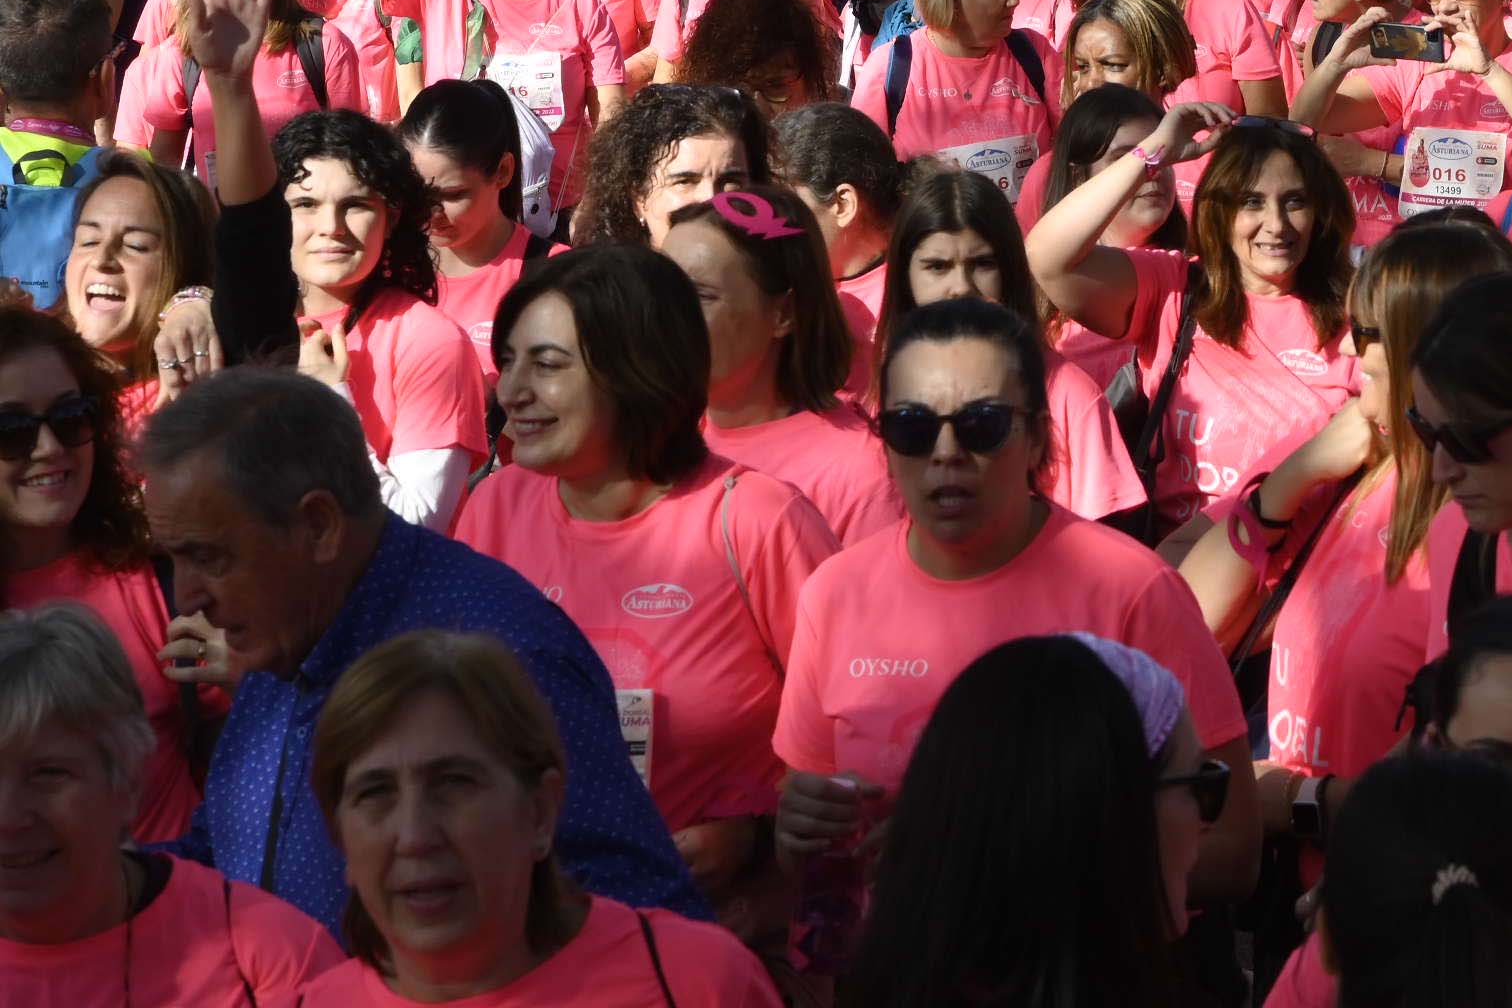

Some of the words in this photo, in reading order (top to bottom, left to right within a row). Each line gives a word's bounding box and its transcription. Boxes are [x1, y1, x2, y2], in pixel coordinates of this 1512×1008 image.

[1431, 145, 1469, 156] ASTURIANA
[1432, 167, 1467, 182] 016
[1435, 185, 1462, 196] 13499
[1352, 191, 1390, 214] MA
[1176, 409, 1215, 446] TU
[626, 595, 688, 610] ASTURIANA
[848, 657, 929, 679] OYSHO
[621, 716, 651, 727] UMA
